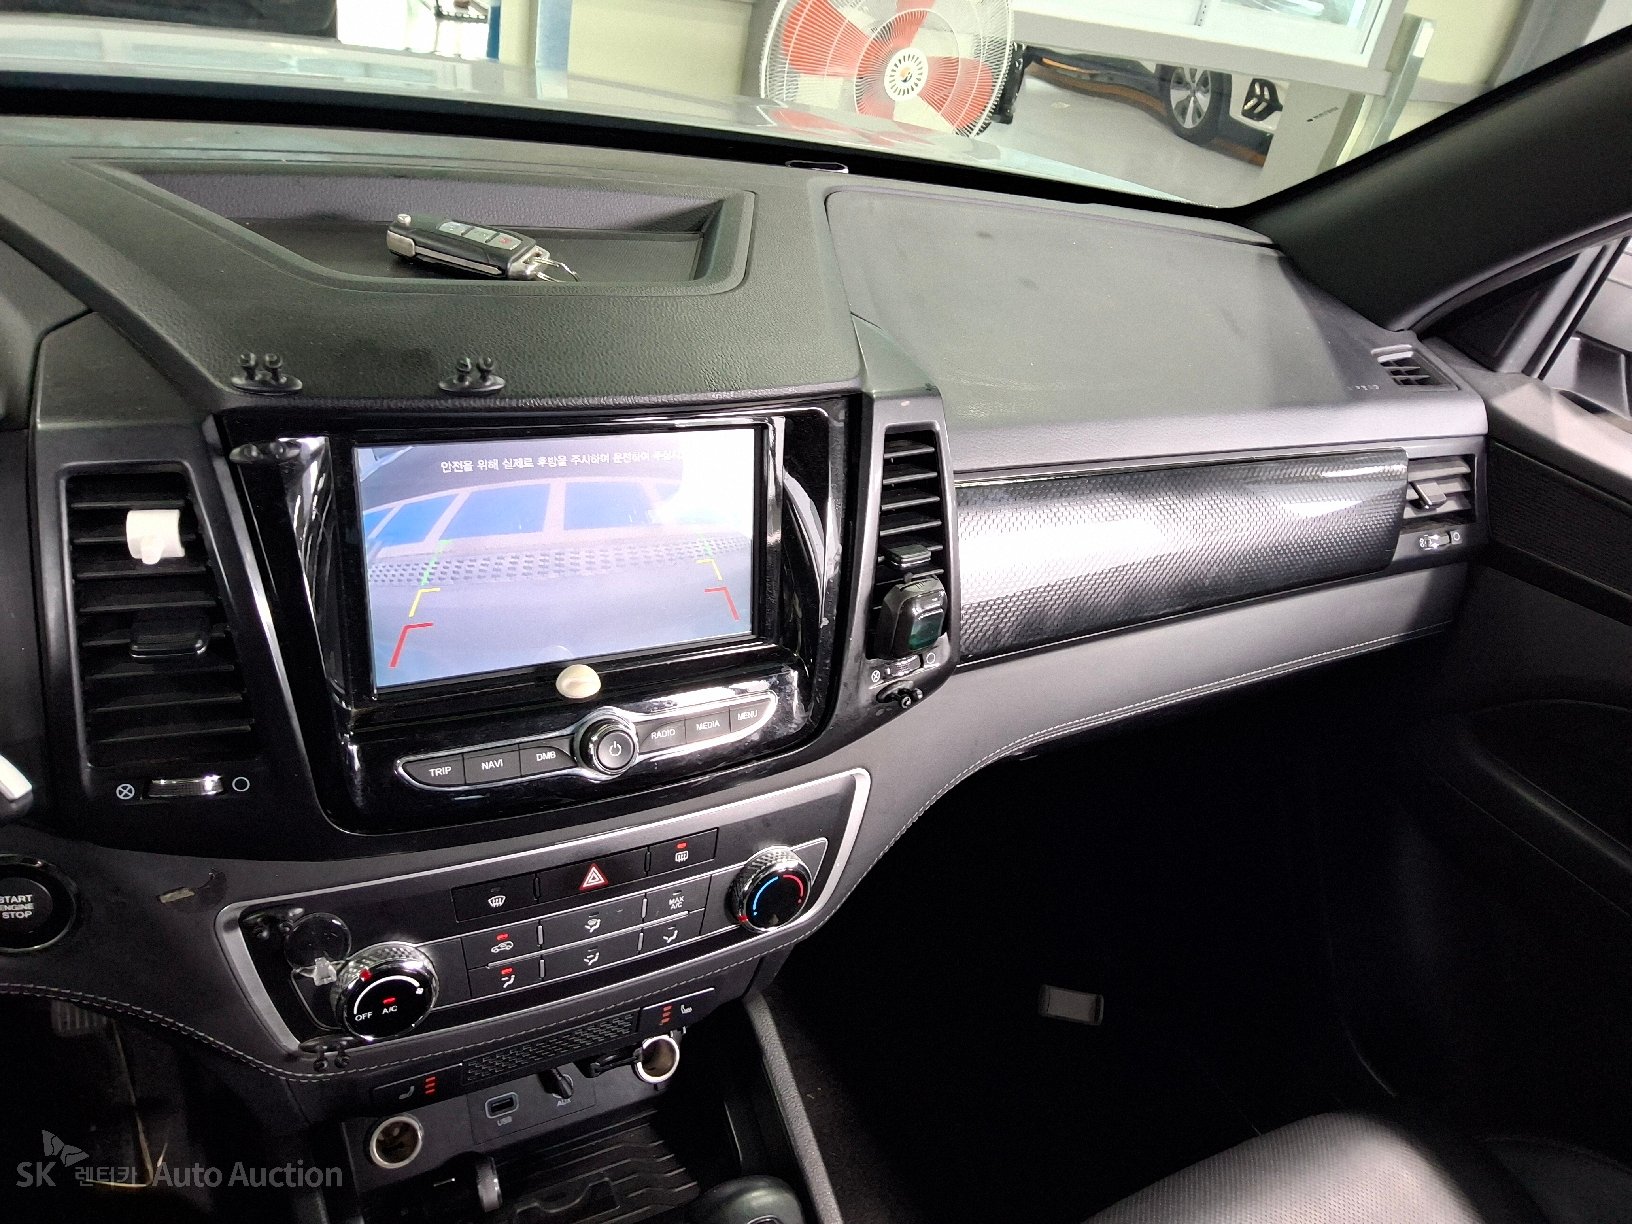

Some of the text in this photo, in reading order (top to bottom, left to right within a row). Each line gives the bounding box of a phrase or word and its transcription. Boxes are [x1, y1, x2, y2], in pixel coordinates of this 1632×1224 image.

[440, 460, 474, 473] 안전을
[477, 459, 499, 471] 위해
[537, 455, 568, 468] 후방을
[737, 710, 758, 720] MENU
[696, 720, 720, 730] MEDIA
[651, 729, 676, 739] RADIO
[536, 751, 556, 761] DMB
[481, 759, 503, 770] NAVI
[429, 766, 452, 777] TRIP
[669, 896, 684, 905] MAX
[670, 902, 683, 910] A/C
[2, 911, 32, 919] STOP
[382, 1005, 398, 1015] A/C
[355, 1011, 373, 1021] OFF
